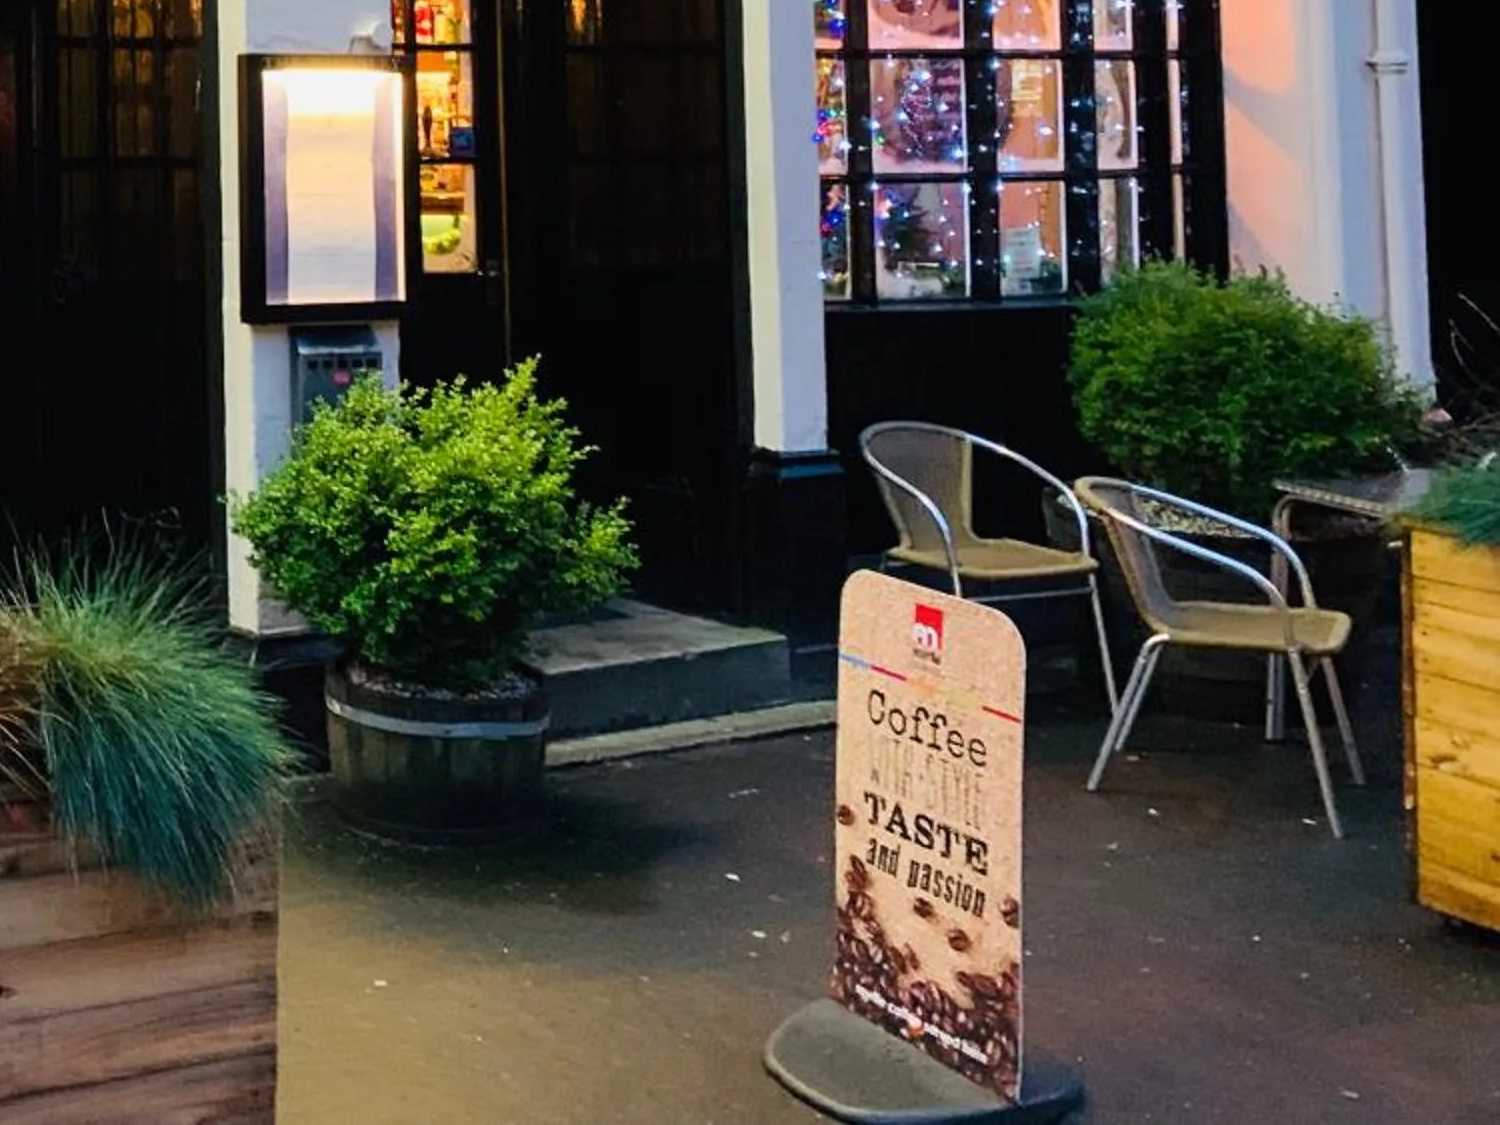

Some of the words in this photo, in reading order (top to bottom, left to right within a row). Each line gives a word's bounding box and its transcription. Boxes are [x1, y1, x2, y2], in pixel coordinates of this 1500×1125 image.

[867, 689, 987, 767] Coffee
[863, 790, 988, 876] TASTE
[865, 838, 901, 878] and
[907, 859, 987, 918] passion
